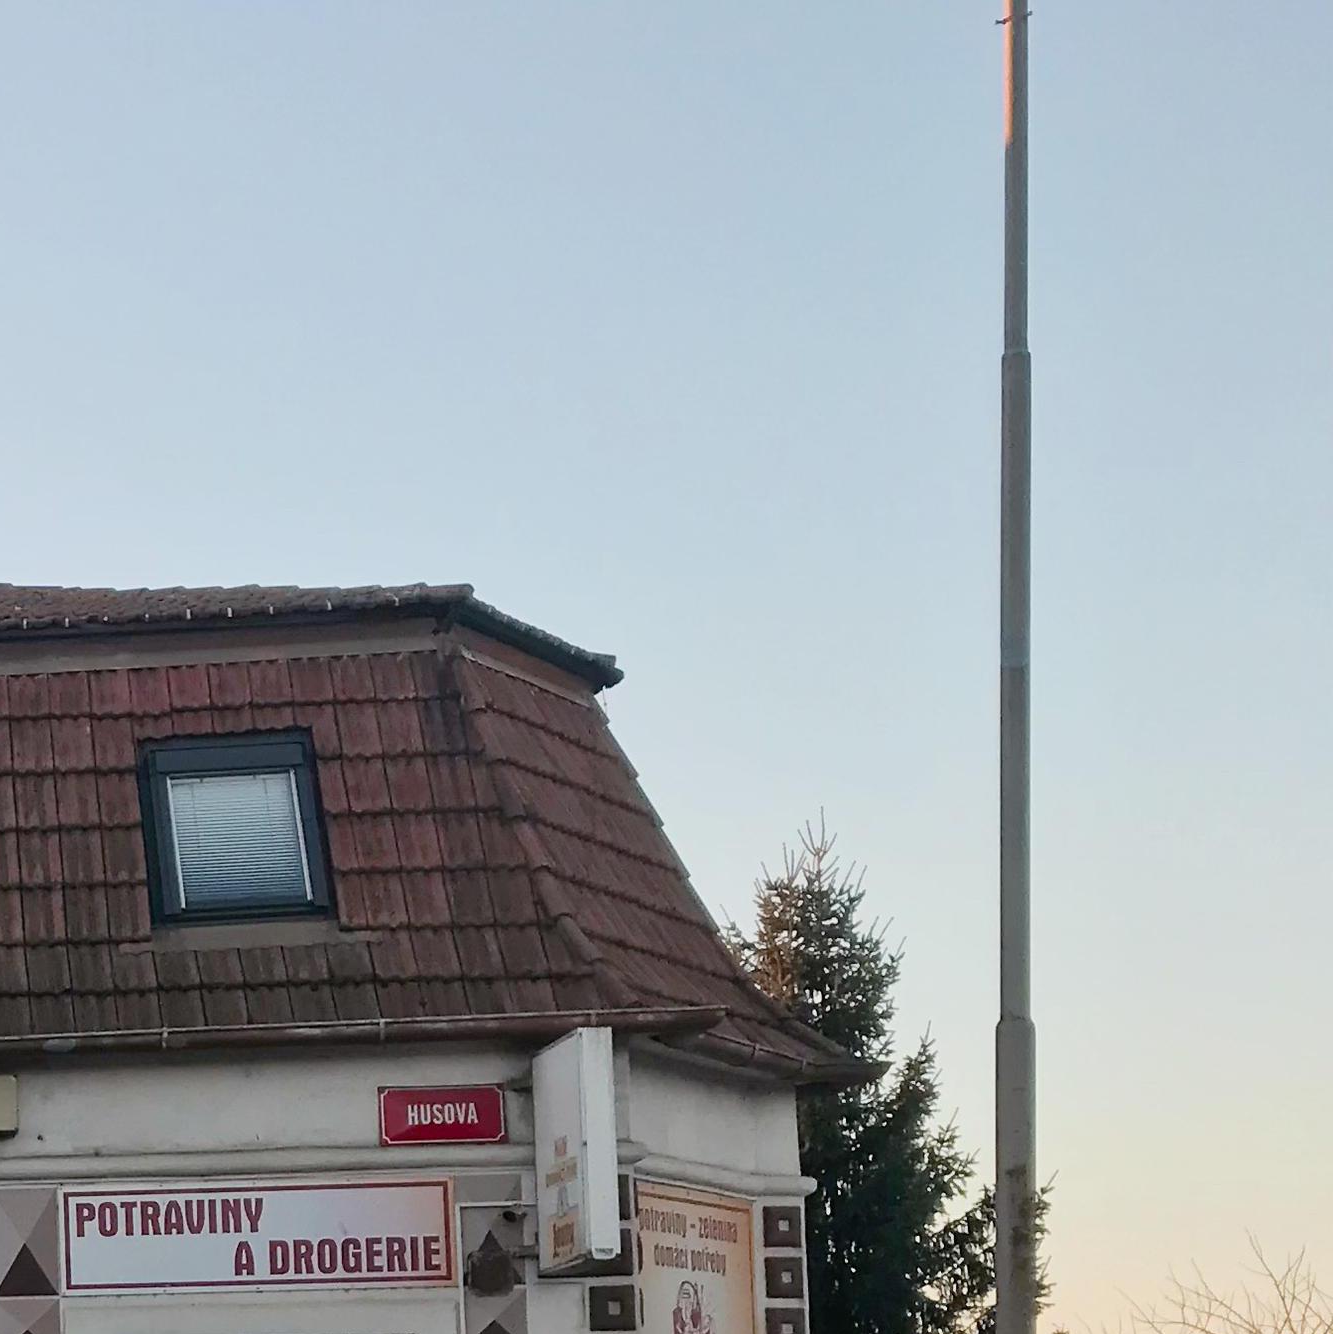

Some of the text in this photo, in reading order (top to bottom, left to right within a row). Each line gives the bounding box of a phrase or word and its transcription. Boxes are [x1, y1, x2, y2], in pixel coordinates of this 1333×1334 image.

[407, 1103, 479, 1126] HUSOVA
[76, 1197, 264, 1237] POTRAVINY
[234, 1235, 442, 1276] A DROGERIE
